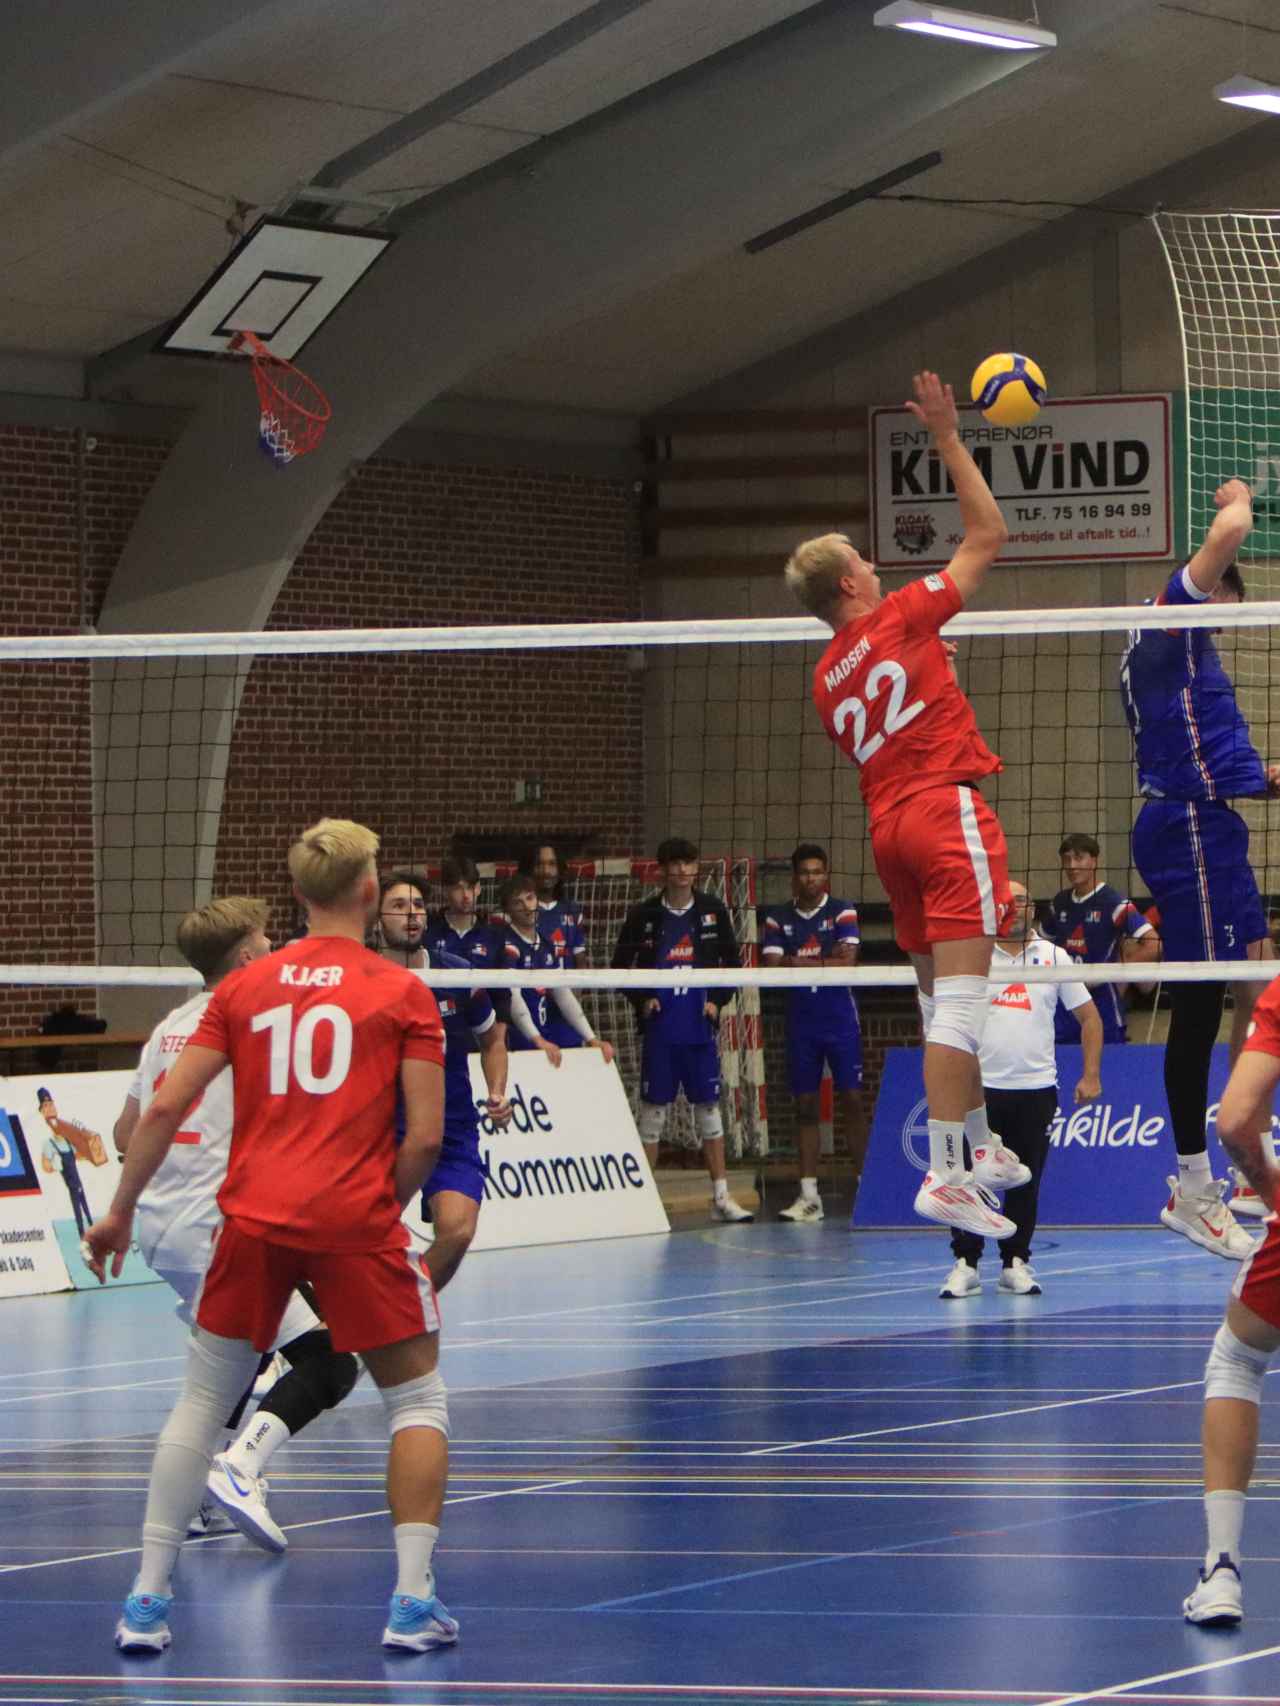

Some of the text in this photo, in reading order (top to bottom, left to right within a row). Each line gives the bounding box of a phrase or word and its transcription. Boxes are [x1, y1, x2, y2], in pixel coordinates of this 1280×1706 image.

[890, 425, 1053, 446] ENTPRENØR
[1016, 508, 1047, 520] TLF.
[1052, 506, 1073, 519] 75
[1079, 505, 1099, 518] 16
[1131, 503, 1151, 516] 99
[824, 634, 871, 693] MADSEN
[833, 660, 926, 764] 22
[279, 964, 344, 987] KJÆR
[251, 1002, 353, 1095] 10
